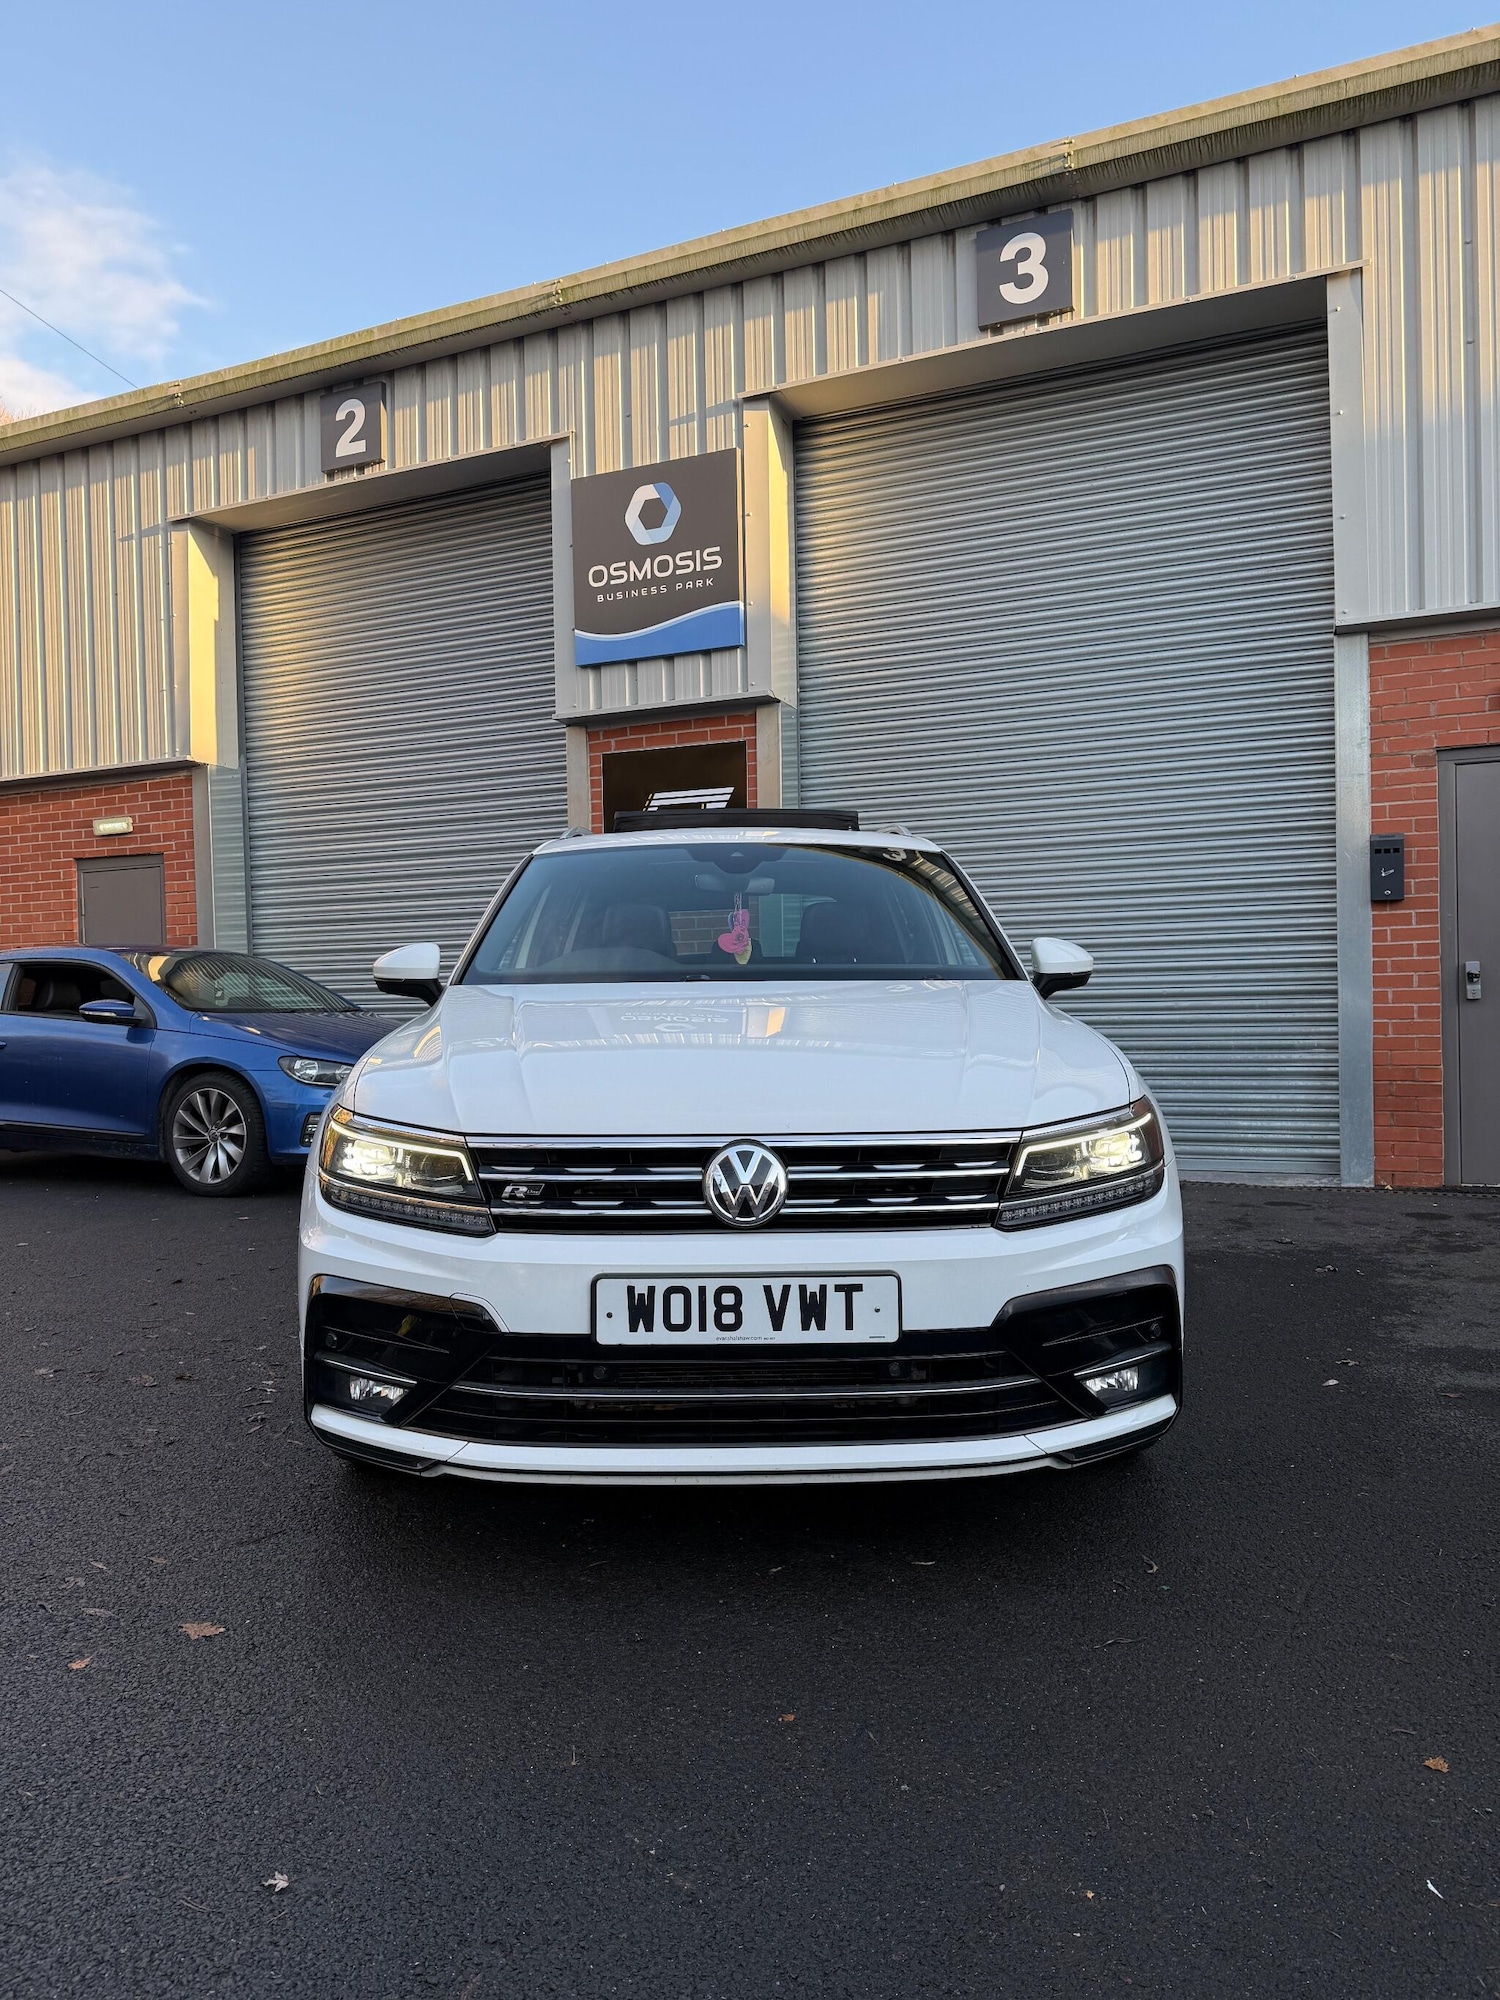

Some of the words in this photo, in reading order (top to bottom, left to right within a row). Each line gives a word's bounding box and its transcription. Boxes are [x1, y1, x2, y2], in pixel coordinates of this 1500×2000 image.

[999, 231, 1049, 305] 3
[335, 398, 367, 458] 2
[588, 546, 723, 588] OSMOSIS
[597, 584, 668, 603] BUSINESS
[676, 577, 714, 591] PARK
[762, 1284, 864, 1331] VWT
